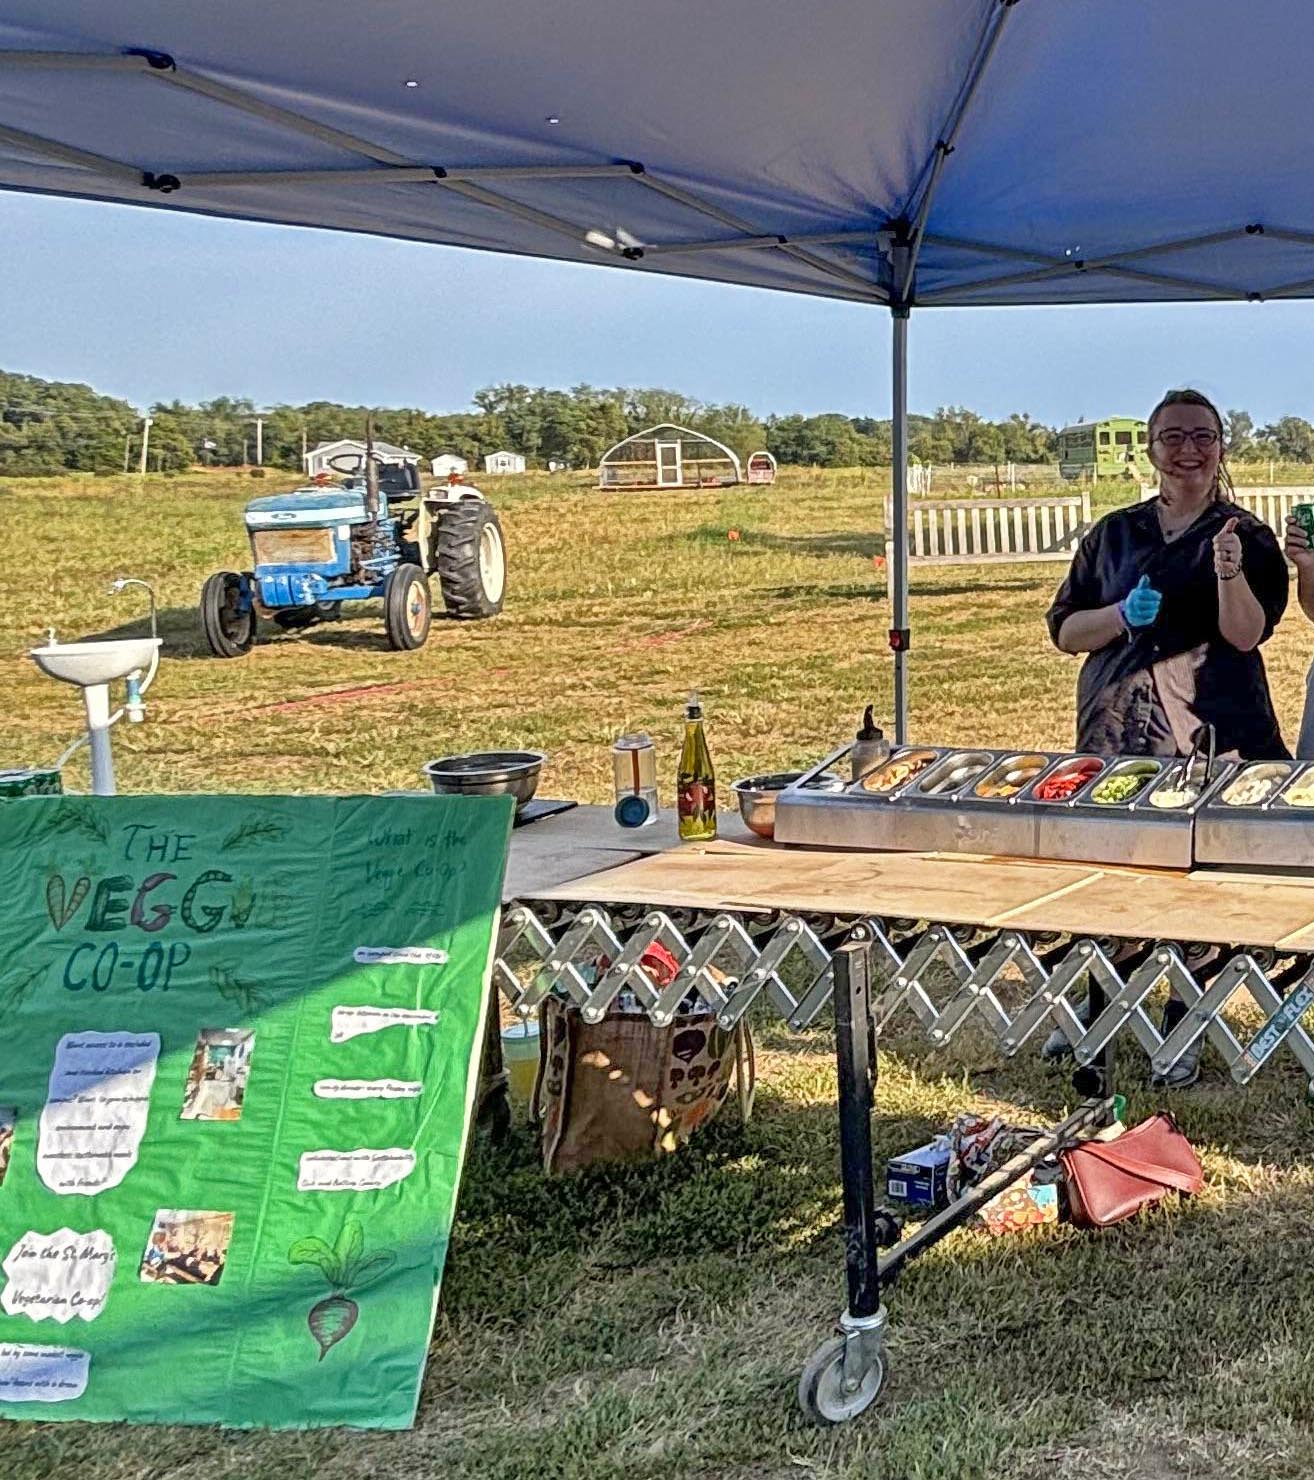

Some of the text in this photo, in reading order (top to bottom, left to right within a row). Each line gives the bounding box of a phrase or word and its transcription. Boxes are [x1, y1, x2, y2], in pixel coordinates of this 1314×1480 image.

[123, 824, 197, 863] THE
[63, 941, 192, 992] CO-OP
[1251, 1023, 1281, 1057] BEST
[12, 1243, 37, 1263] Join
[40, 1245, 58, 1260] the
[11, 1289, 68, 1307] Vegetarian
